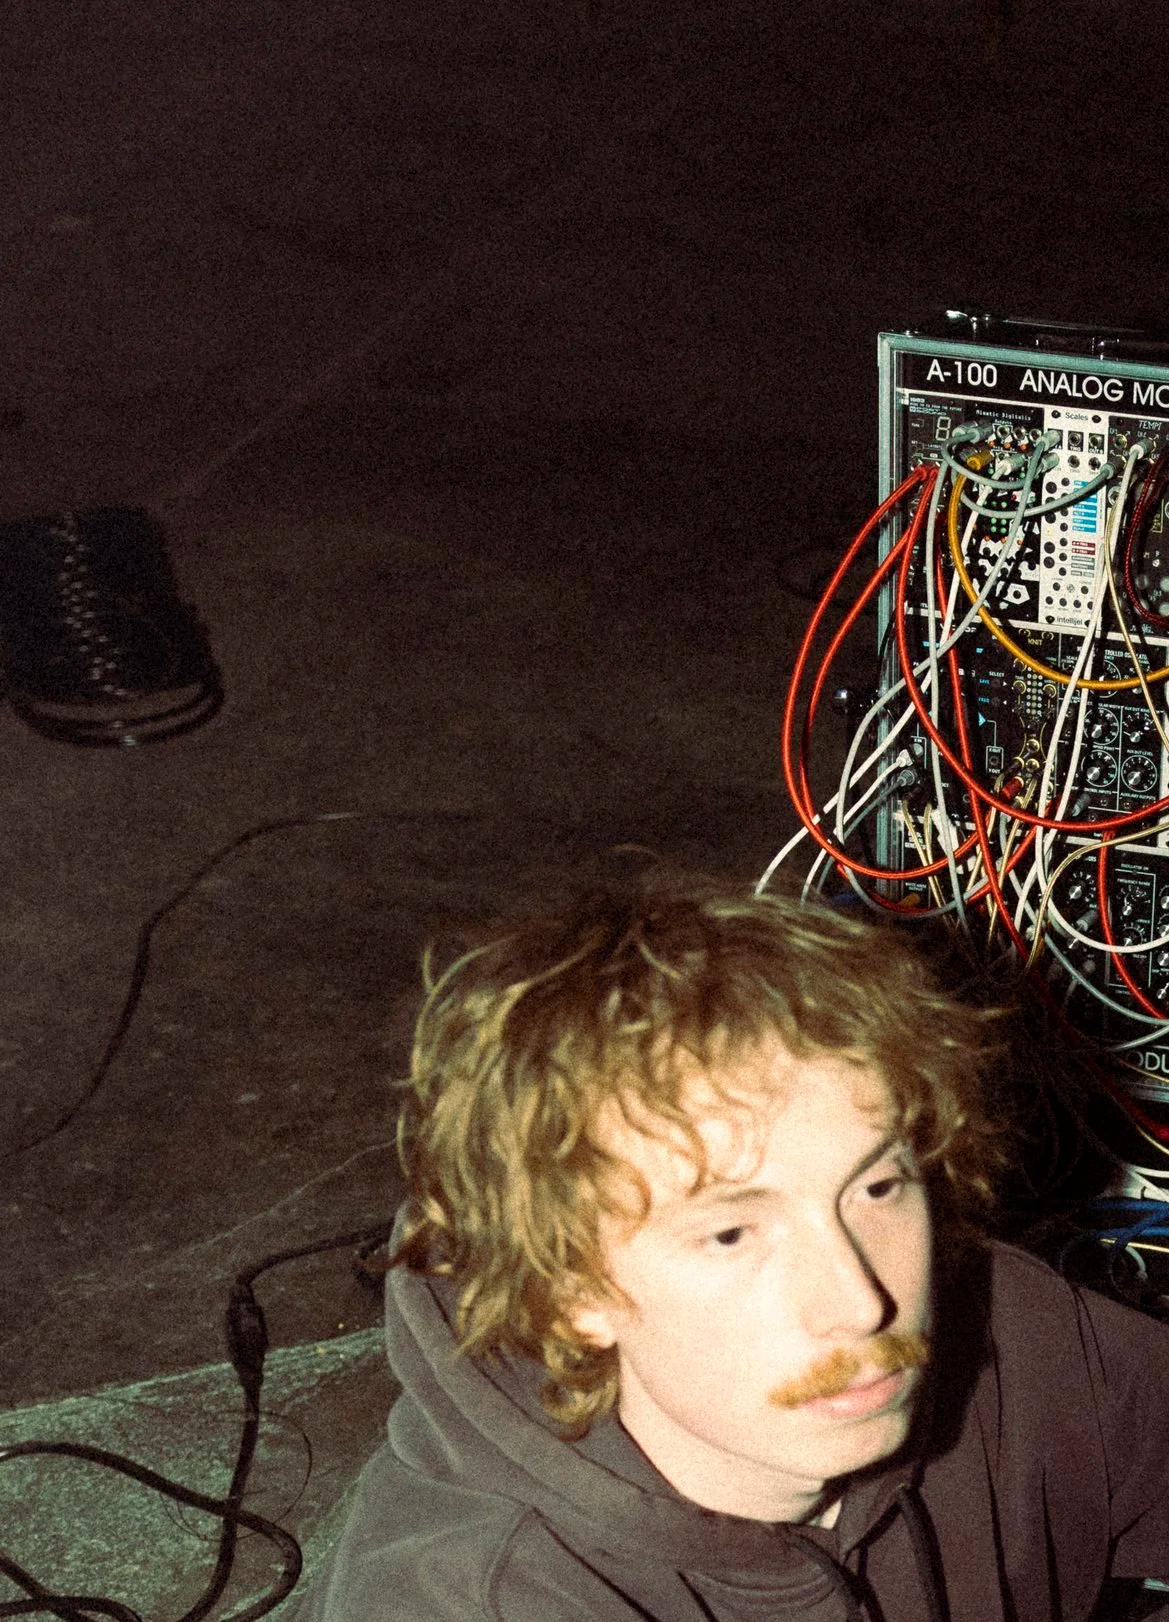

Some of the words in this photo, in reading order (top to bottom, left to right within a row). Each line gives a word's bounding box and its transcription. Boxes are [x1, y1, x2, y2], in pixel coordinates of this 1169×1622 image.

[926, 359, 998, 388] A-100
[1019, 369, 1124, 402] ANALOG
[1065, 412, 1089, 421] Scales
[1139, 420, 1162, 431] TEMPI
[1056, 617, 1083, 626] intellijel
[1104, 649, 1127, 657] TROLLED
